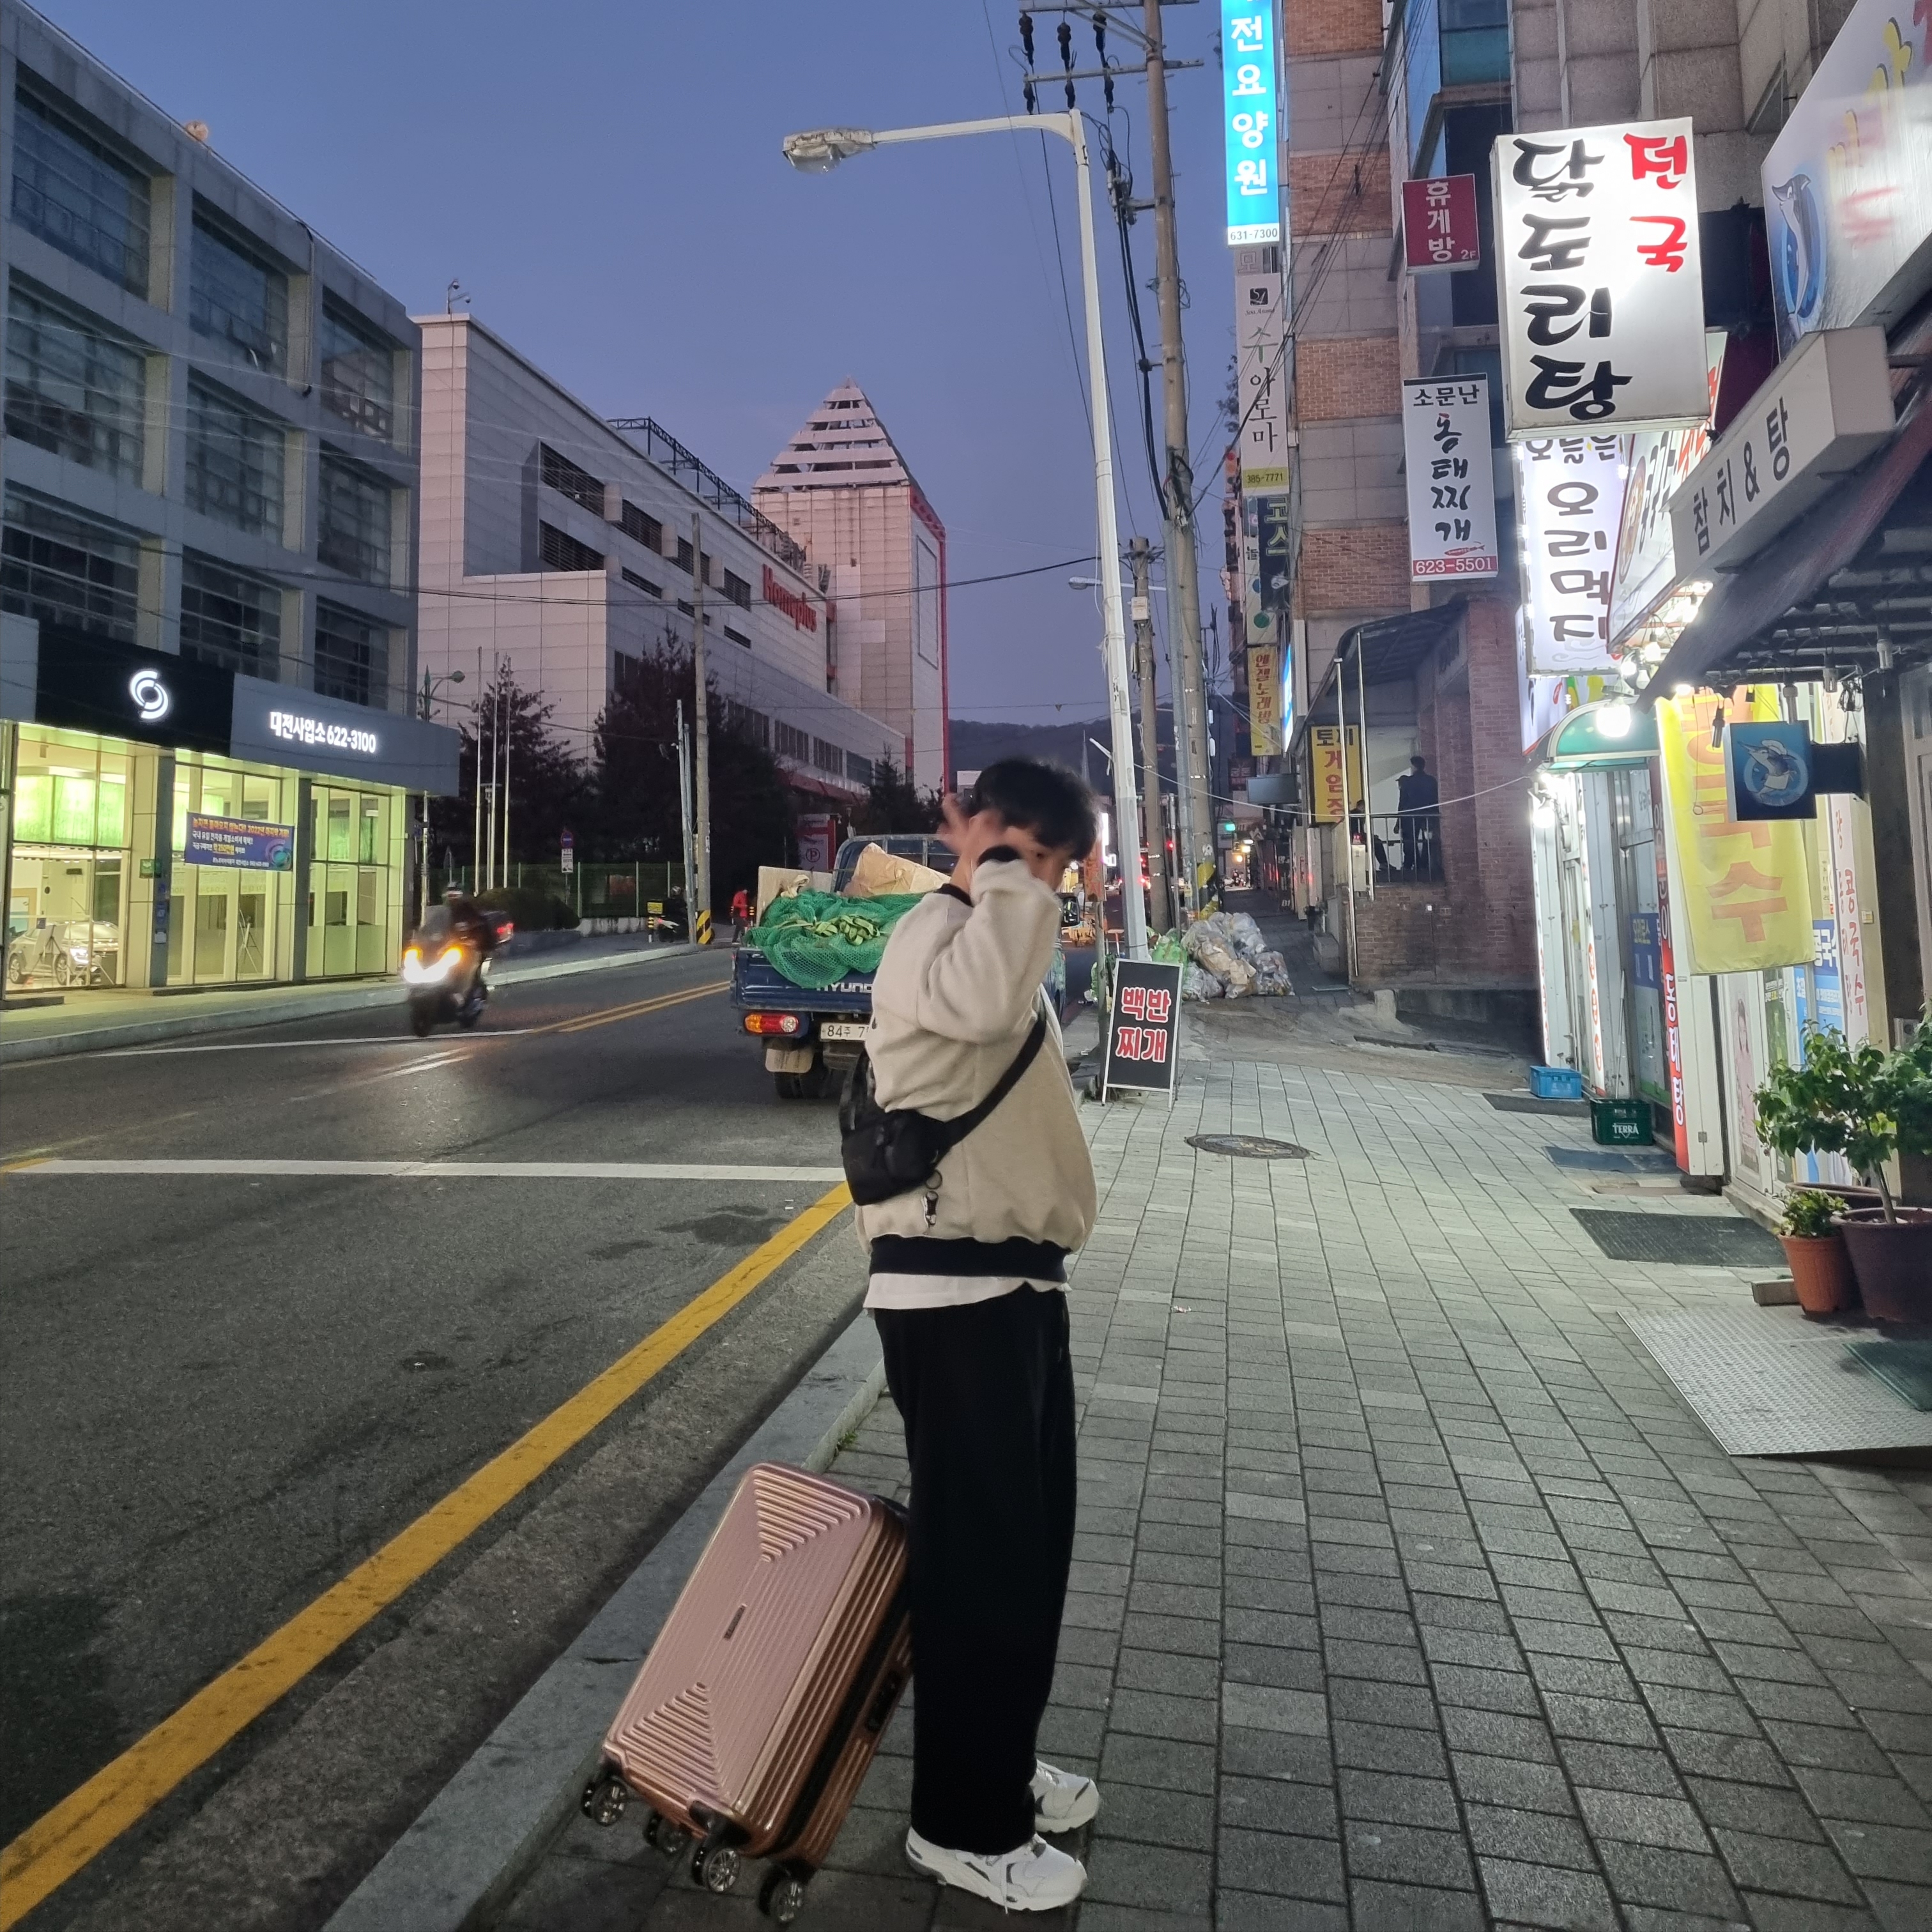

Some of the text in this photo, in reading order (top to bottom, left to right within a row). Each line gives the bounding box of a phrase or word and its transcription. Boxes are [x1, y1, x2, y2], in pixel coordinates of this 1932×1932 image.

[1230, 0, 1268, 195] 전요양원
[1230, 228, 1278, 240] 631-7300
[1425, 181, 1455, 262] 휴게방
[1460, 249, 1476, 260] 2F
[1512, 137, 1633, 420] 닭도리탕
[1241, 326, 1278, 452] 수아로마
[1413, 384, 1480, 407] 소문난
[1432, 413, 1471, 542] 동태찌개
[1416, 558, 1492, 574] 623-5501
[270, 711, 376, 753] 대전사업소 622-3100
[1844, 869, 1865, 1016] 콩국수
[1121, 987, 1172, 1023] 백반
[827, 1025, 851, 1038] 84주
[1116, 1027, 1168, 1063] 찌개
[1612, 1123, 1639, 1135] TERRA
